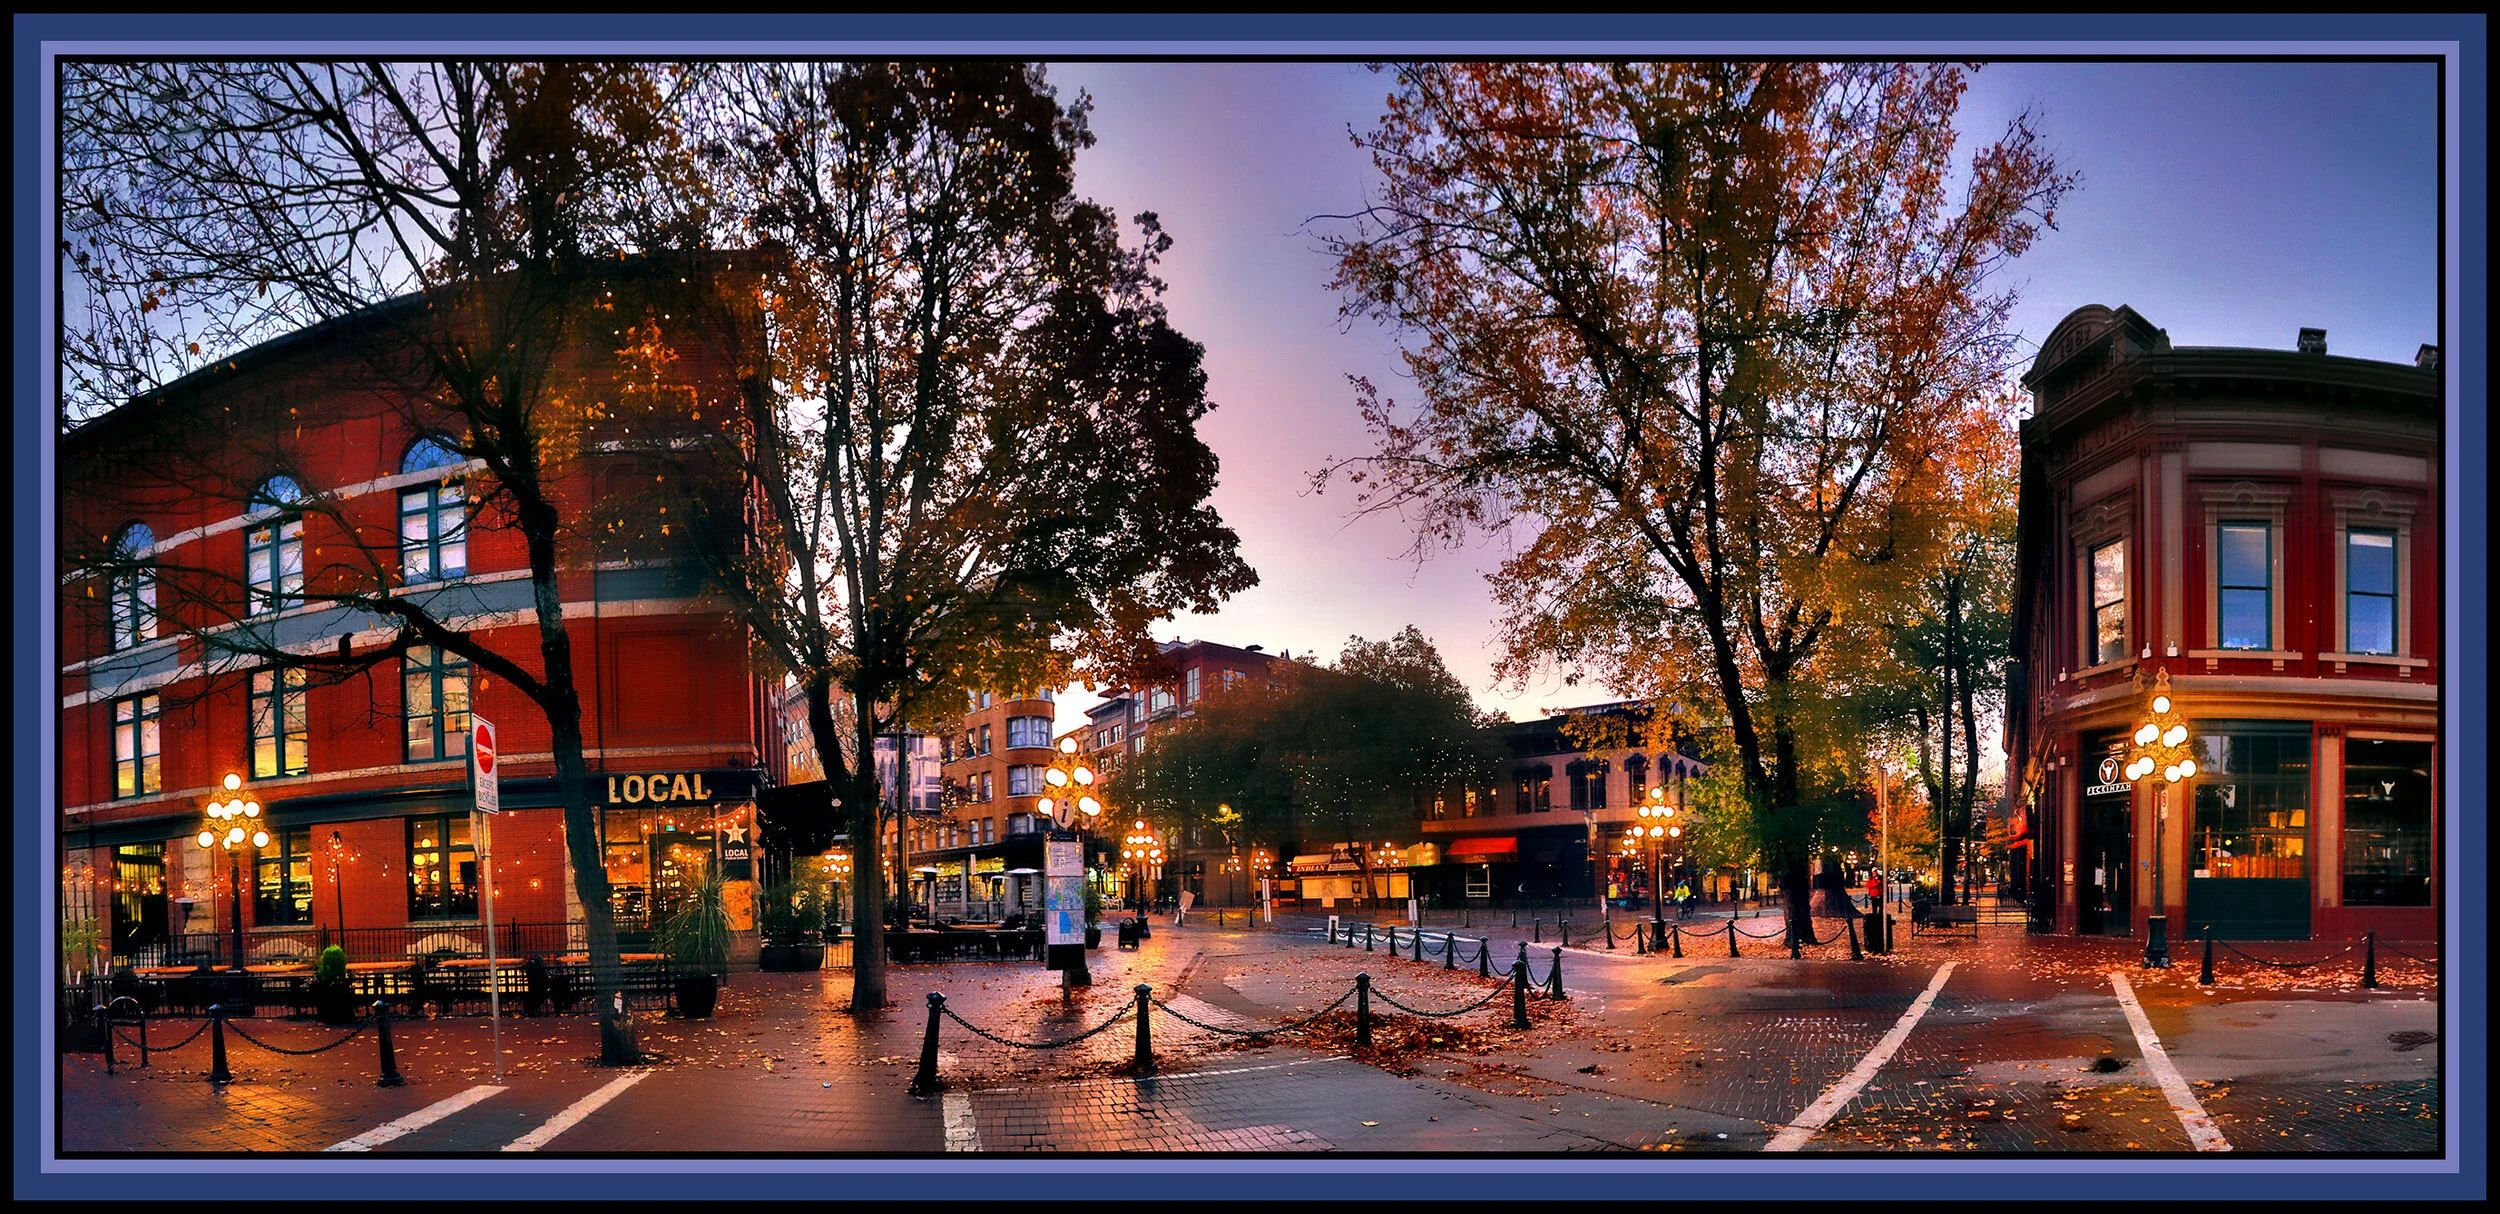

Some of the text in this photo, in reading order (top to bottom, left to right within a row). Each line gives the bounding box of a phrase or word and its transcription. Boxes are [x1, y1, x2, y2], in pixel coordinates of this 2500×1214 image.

[608, 773, 708, 803] LOCAL
[2087, 782, 2131, 796] PECKINPAH
[724, 848, 749, 857] LOCAL
[1296, 865, 1326, 873] INDIAN
